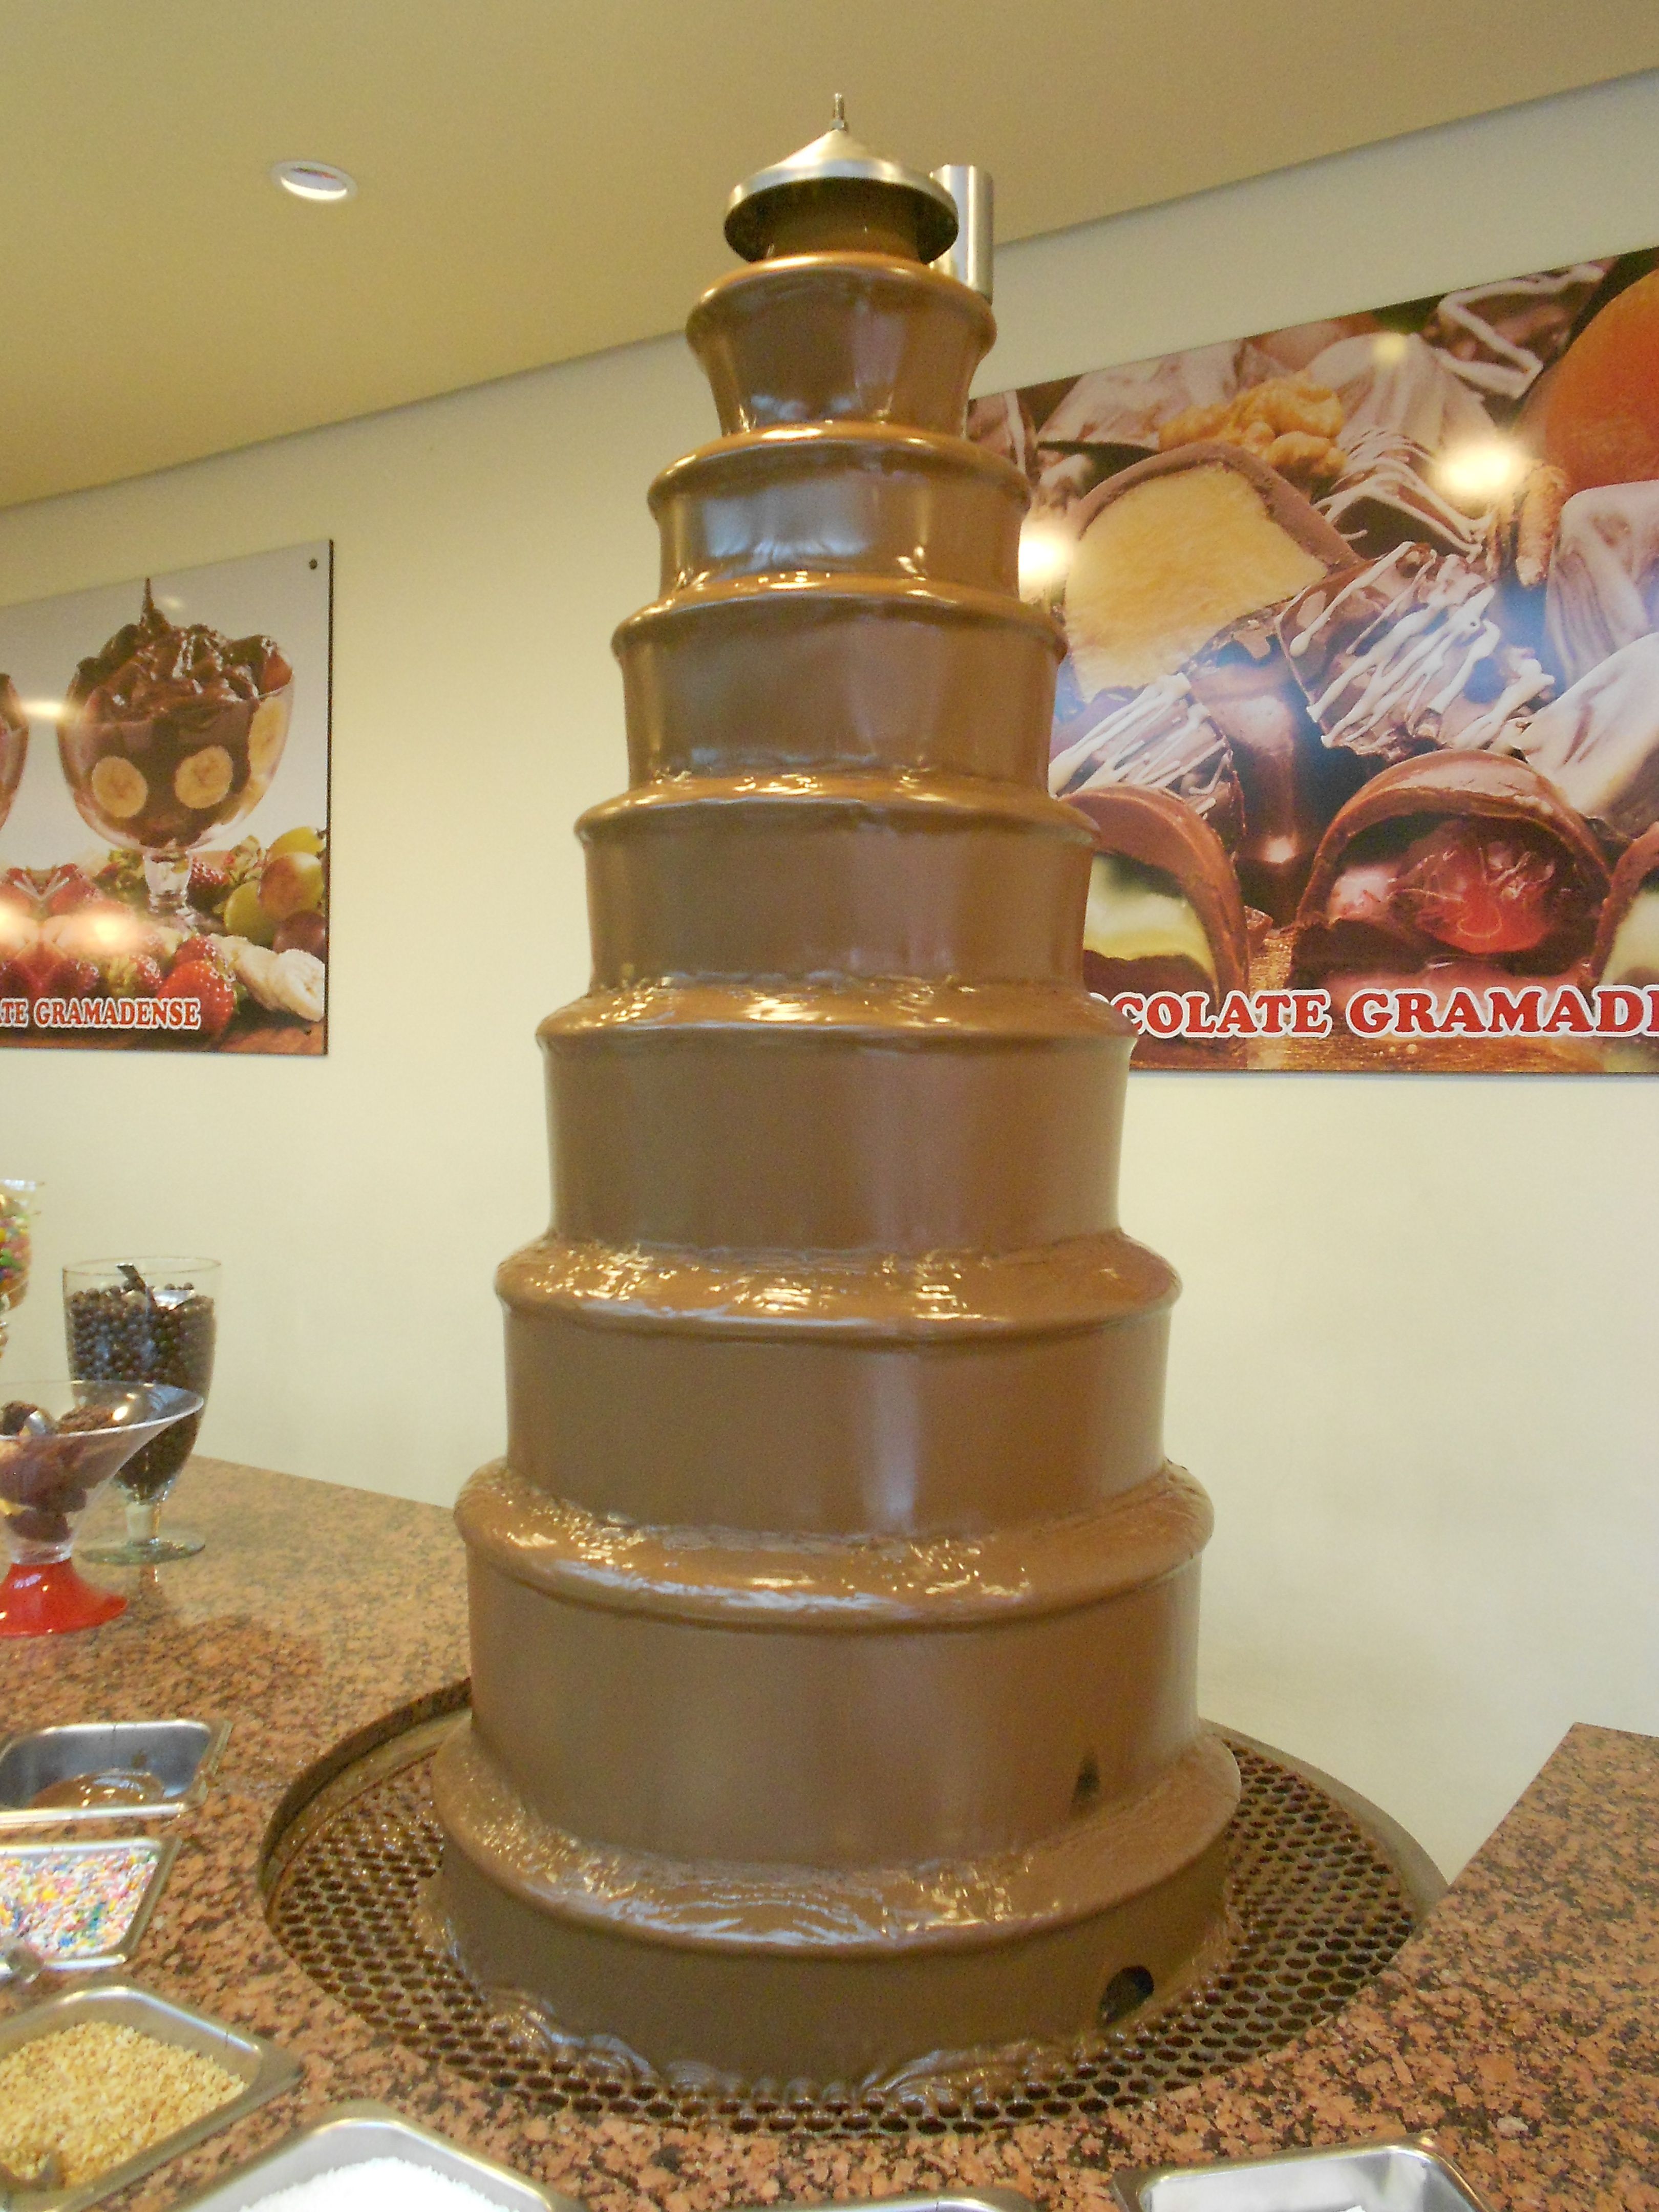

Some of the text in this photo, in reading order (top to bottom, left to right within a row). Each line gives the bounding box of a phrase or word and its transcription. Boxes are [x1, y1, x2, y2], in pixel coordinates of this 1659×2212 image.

[0, 997, 201, 1030] TE GRAMADENSE
[1091, 985, 1659, 1038] COLATE GRAMAD
